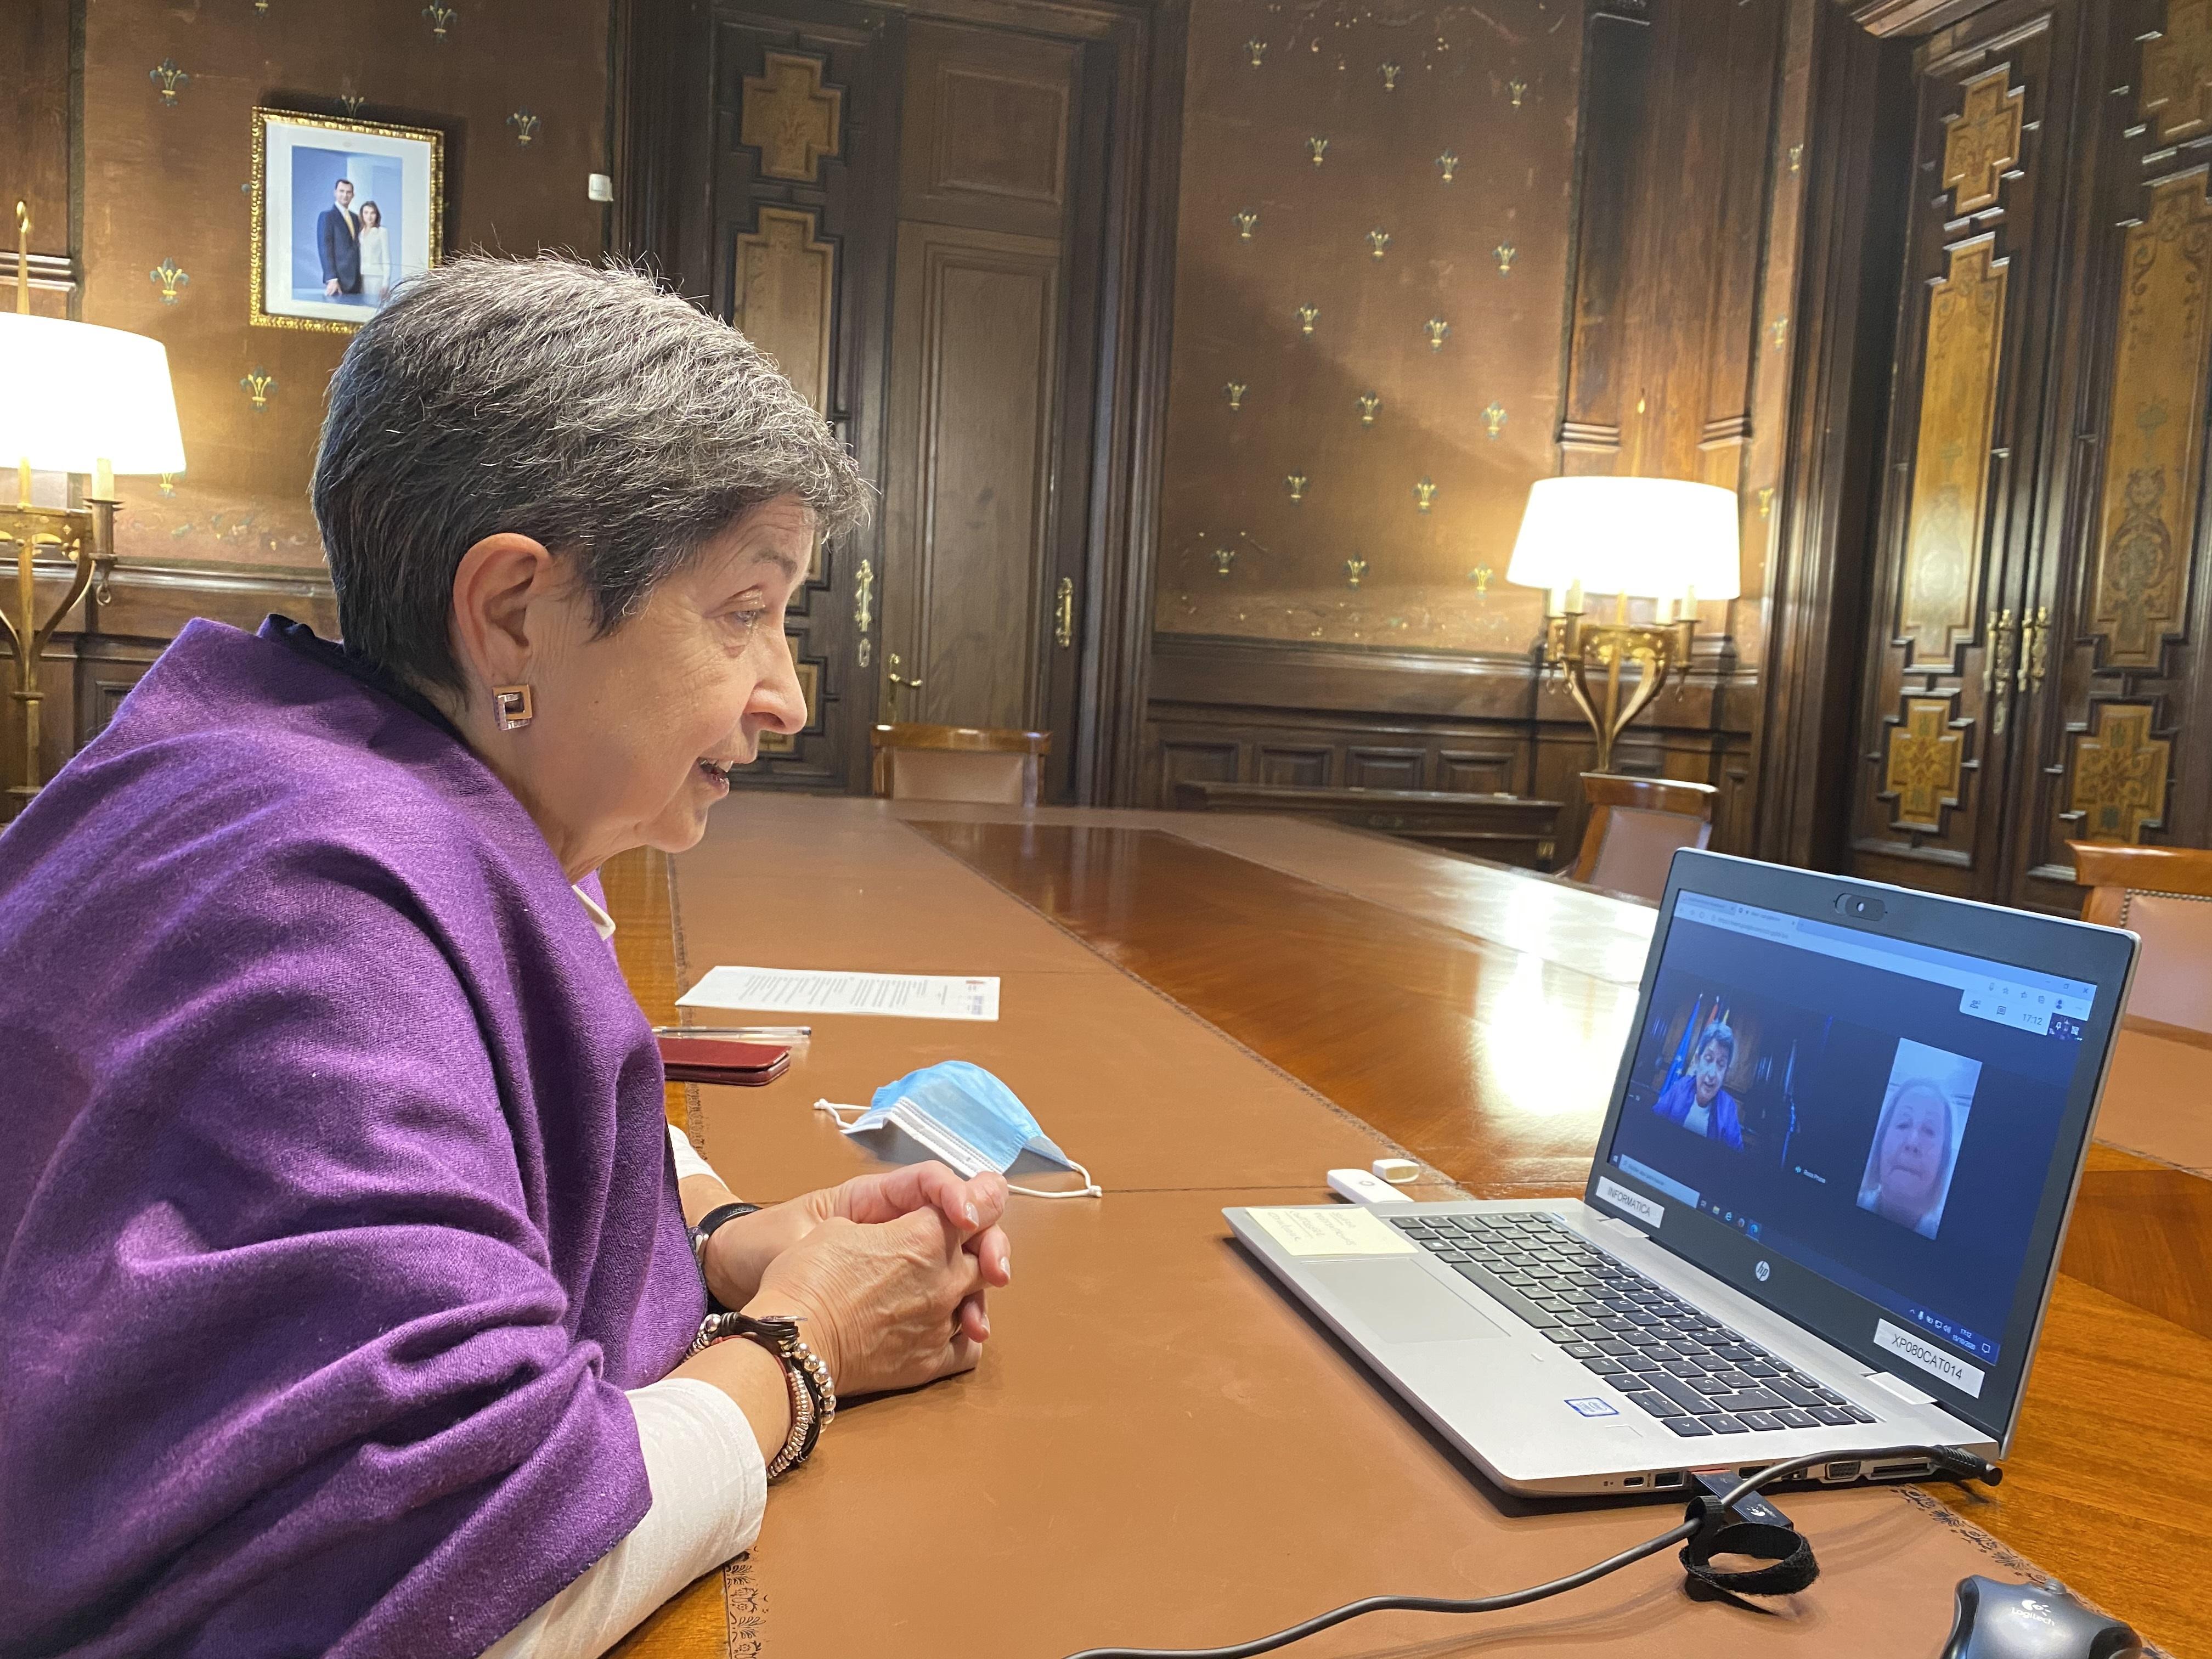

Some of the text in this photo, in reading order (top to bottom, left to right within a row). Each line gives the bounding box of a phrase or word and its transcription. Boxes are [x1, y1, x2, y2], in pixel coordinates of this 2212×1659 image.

[2023, 1013, 2042, 1025] 17:12
[1607, 1186, 1651, 1217] INFORMATICA
[1756, 1261, 1769, 1280] hp
[1960, 1328, 1972, 1339] 17:12
[1892, 1334, 1963, 1380] XP080CAT014
[2011, 1606, 2055, 1627] Logitech
